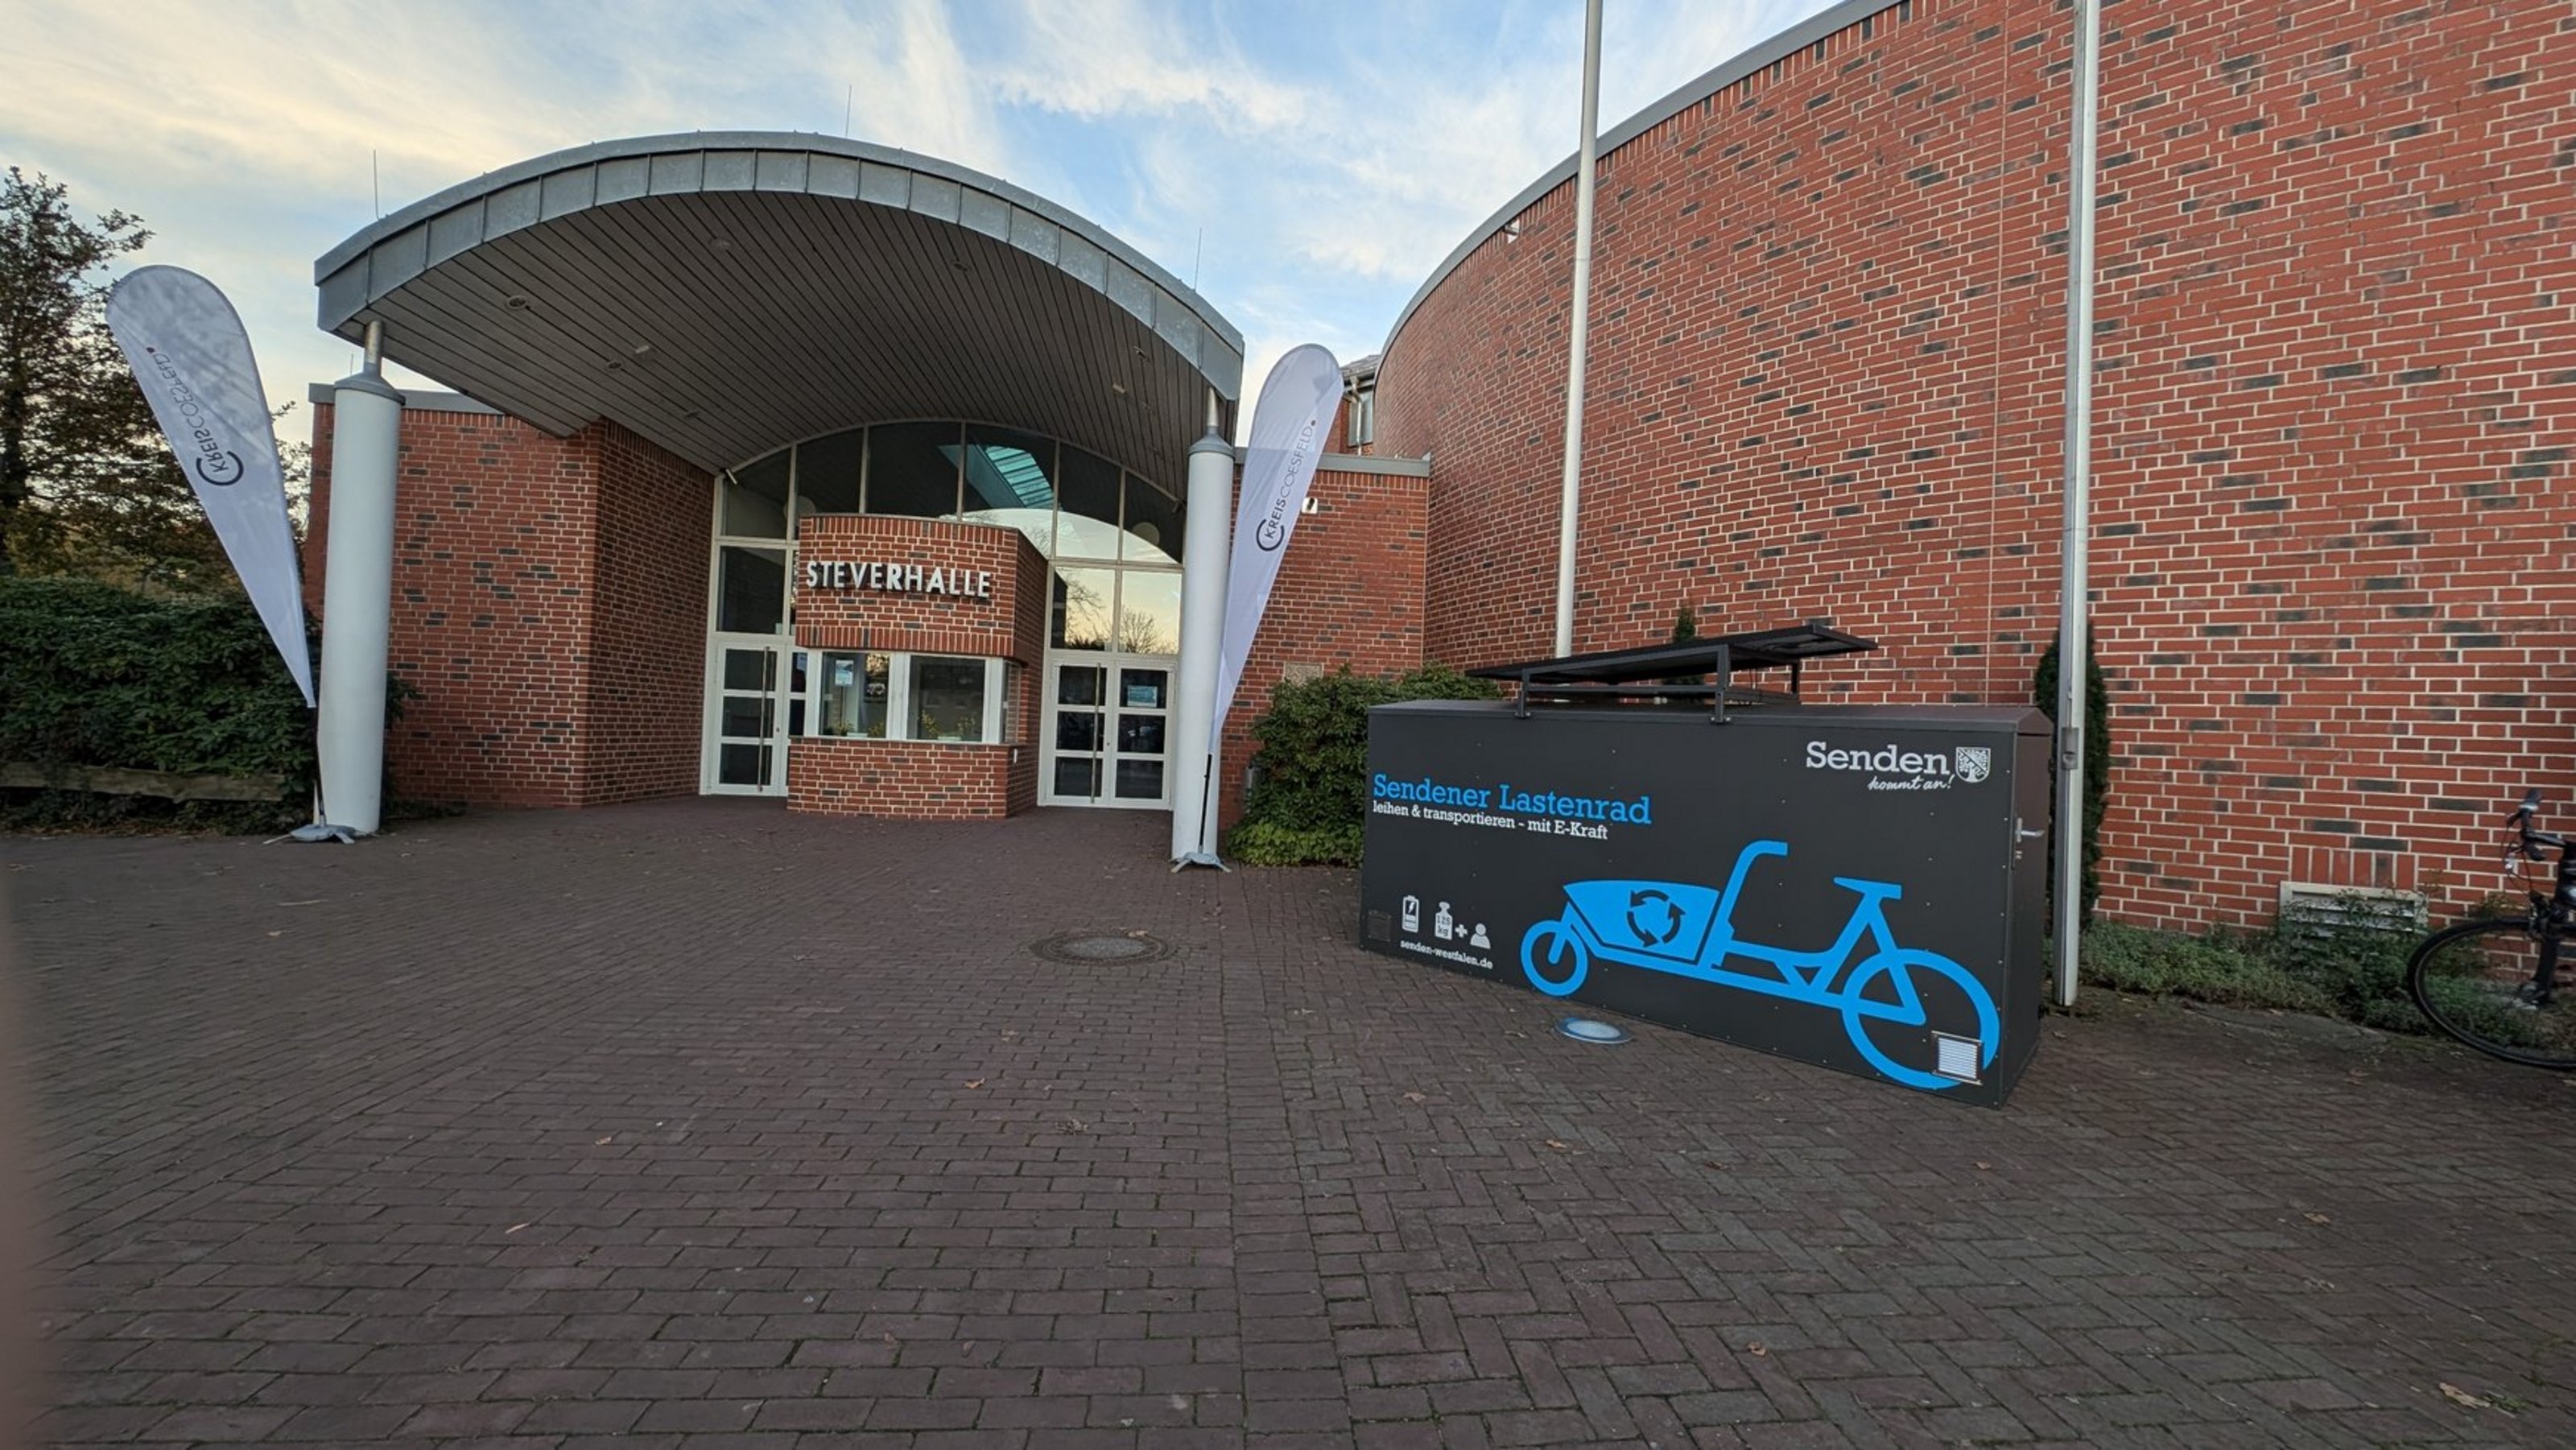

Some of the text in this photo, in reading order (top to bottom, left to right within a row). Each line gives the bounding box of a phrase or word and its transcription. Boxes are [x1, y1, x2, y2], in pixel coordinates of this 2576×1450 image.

[806, 560, 991, 597] STEVERHALLE
[1806, 741, 1950, 775] Senden
[1868, 774, 1955, 791] kommt an!
[1373, 773, 1652, 824] Sendener Lastenrad
[1373, 800, 1409, 816] leihen
[1411, 804, 1421, 817] &
[1423, 807, 1515, 828] transportieren
[1527, 819, 1551, 833] mit
[1554, 820, 1608, 840] E-Kraft
[1437, 915, 1451, 925] 125
[1438, 926, 1448, 937] kg
[1400, 940, 1493, 969] senden-westfalen.de
